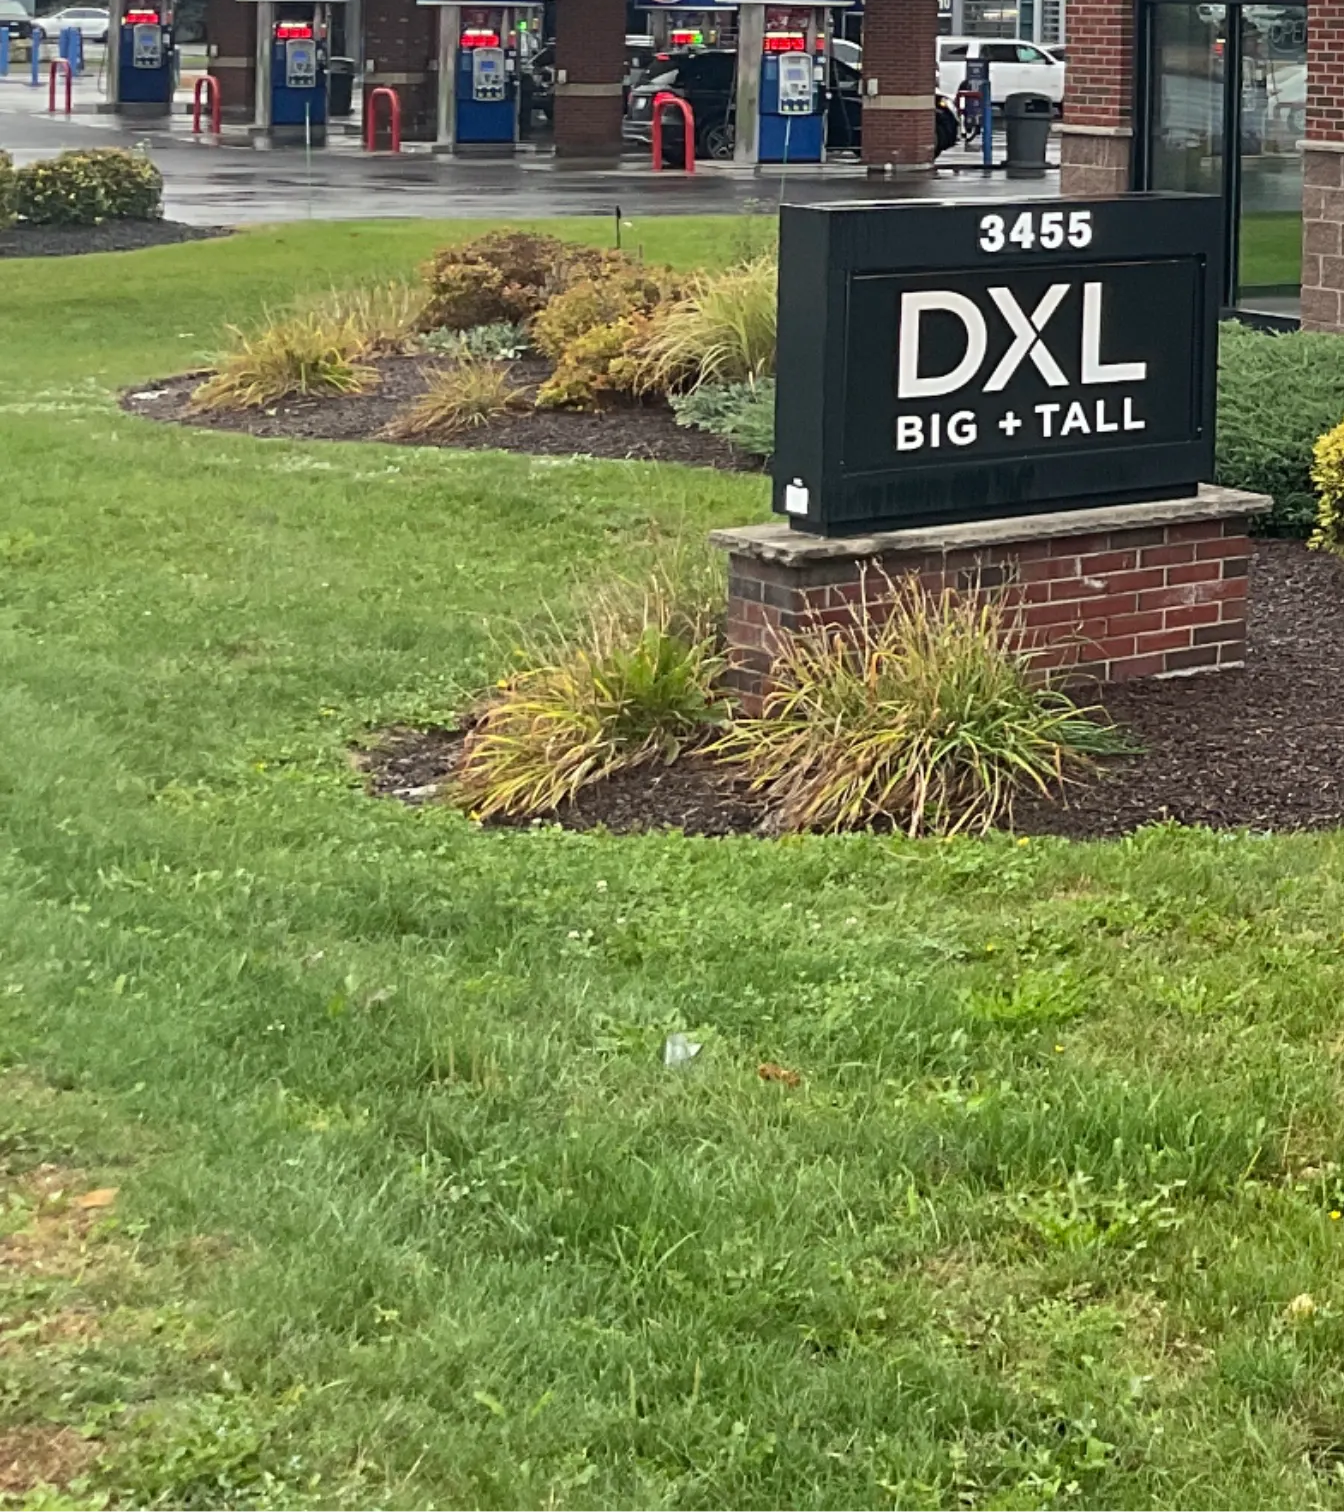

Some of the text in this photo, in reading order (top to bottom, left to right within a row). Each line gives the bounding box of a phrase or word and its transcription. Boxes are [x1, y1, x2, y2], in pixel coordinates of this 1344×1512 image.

[979, 210, 1093, 253] 3455
[897, 281, 1147, 398] DXL
[896, 396, 1146, 451] BIG + TALL
